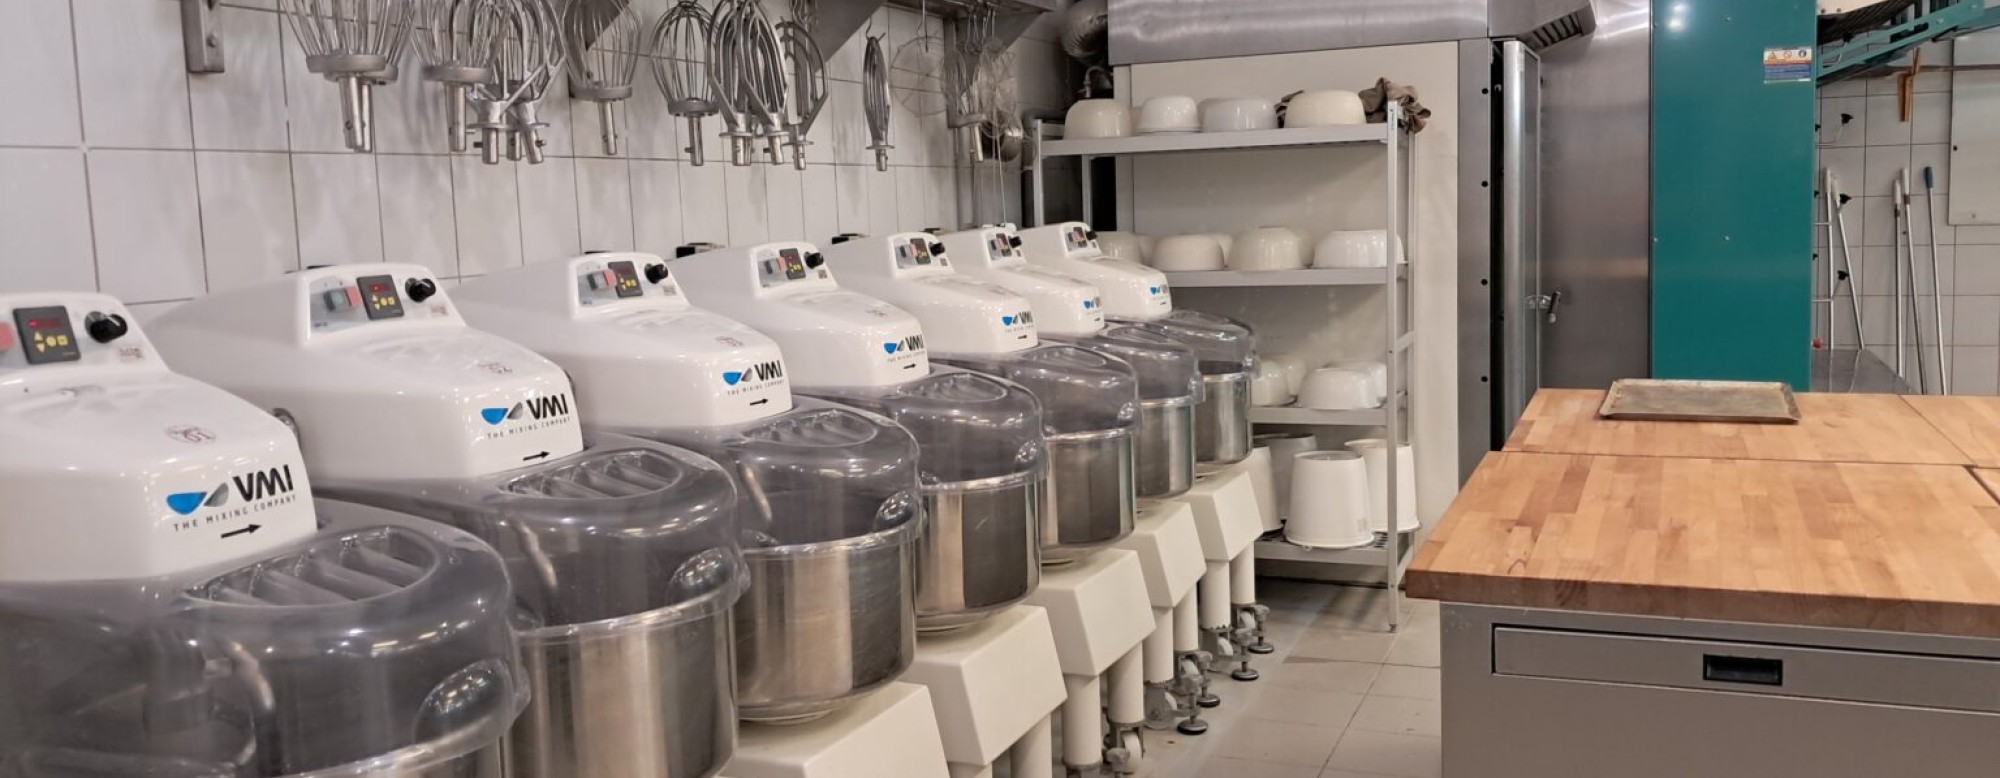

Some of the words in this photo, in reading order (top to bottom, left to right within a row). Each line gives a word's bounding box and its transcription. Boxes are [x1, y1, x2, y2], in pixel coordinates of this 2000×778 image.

[753, 359, 783, 381] VMI
[525, 393, 569, 420] VMI
[232, 464, 294, 502] VMI
[173, 519, 198, 532] THE
[206, 506, 249, 524] MIXING
[254, 494, 296, 512] COMPANY
